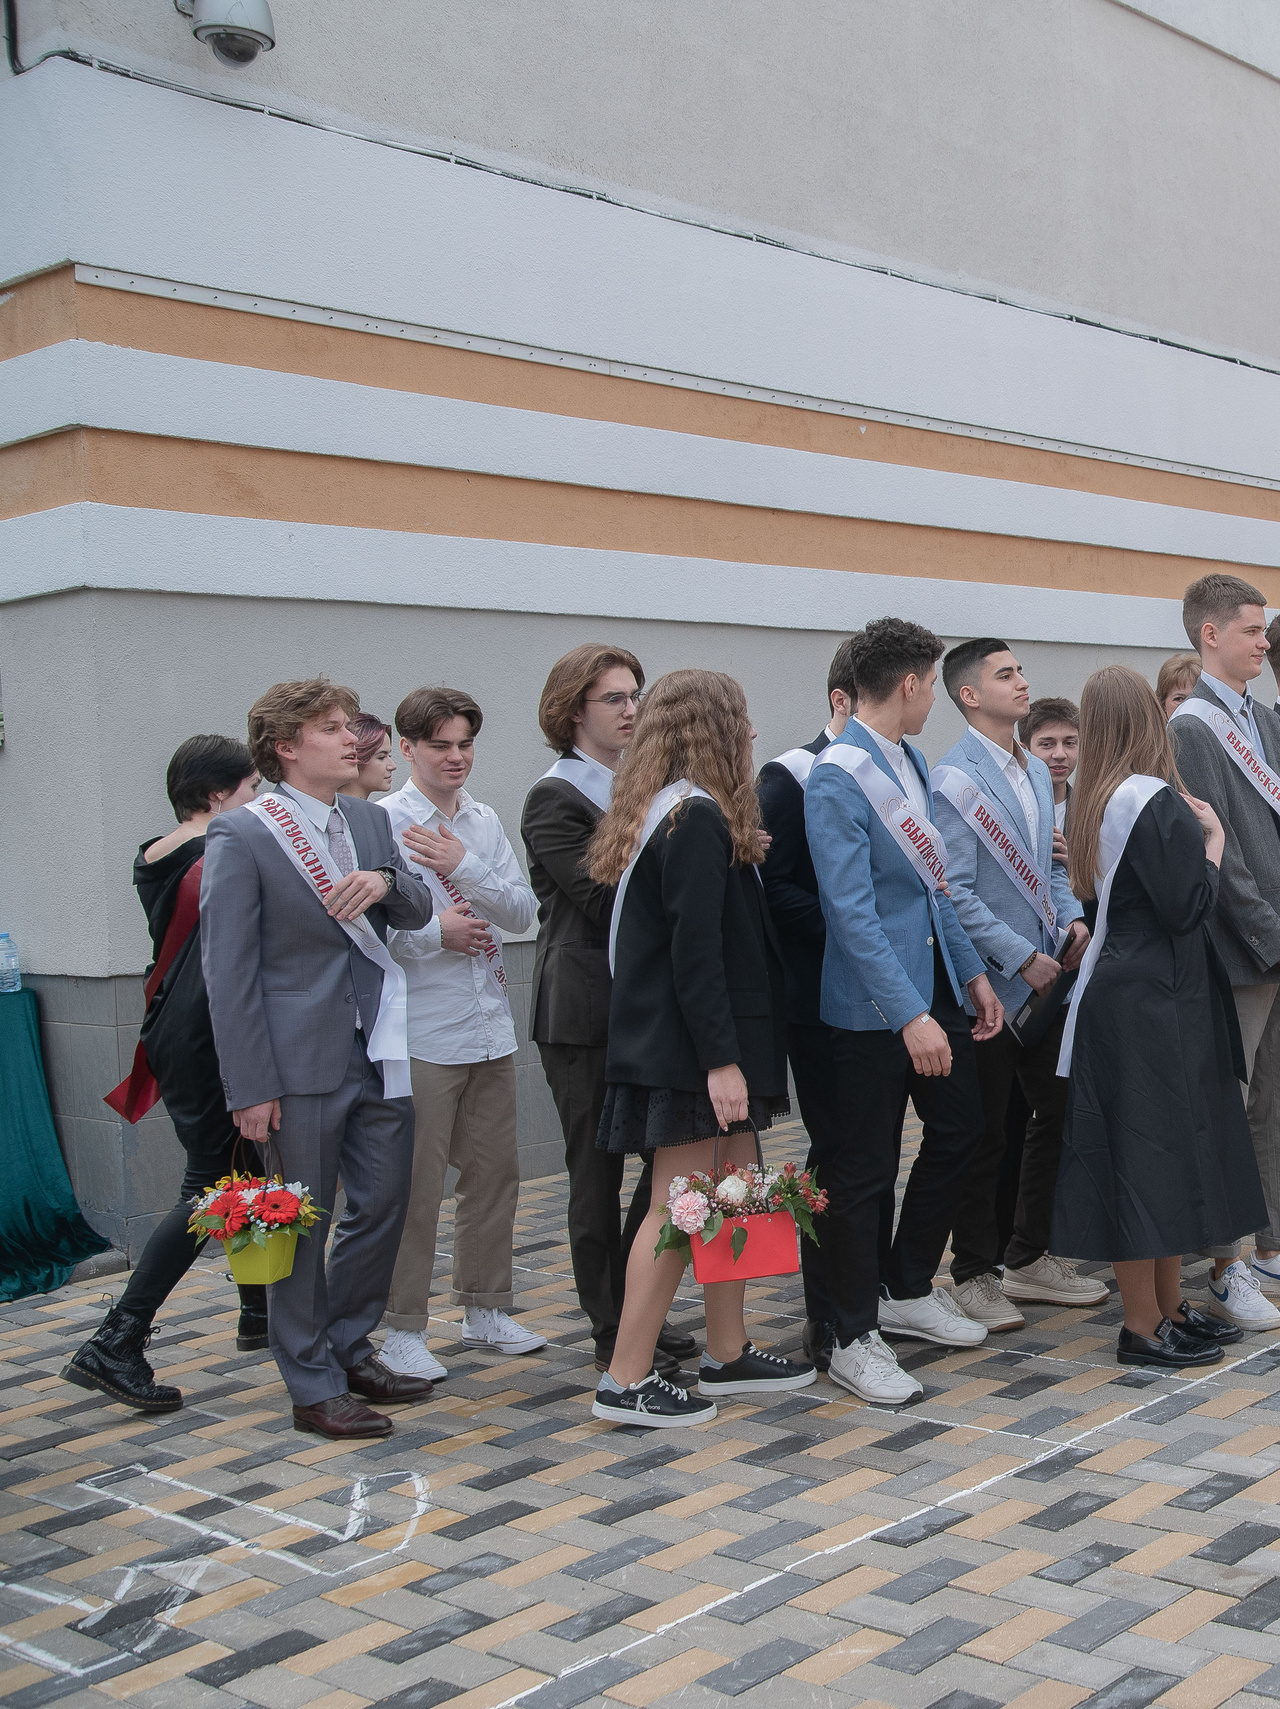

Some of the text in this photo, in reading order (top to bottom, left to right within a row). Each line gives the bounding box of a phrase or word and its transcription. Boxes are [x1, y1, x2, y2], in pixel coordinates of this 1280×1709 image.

[899, 816, 946, 883] ВЫПУСКН
[974, 804, 1056, 927] ВЫПУСКНИК 2023
